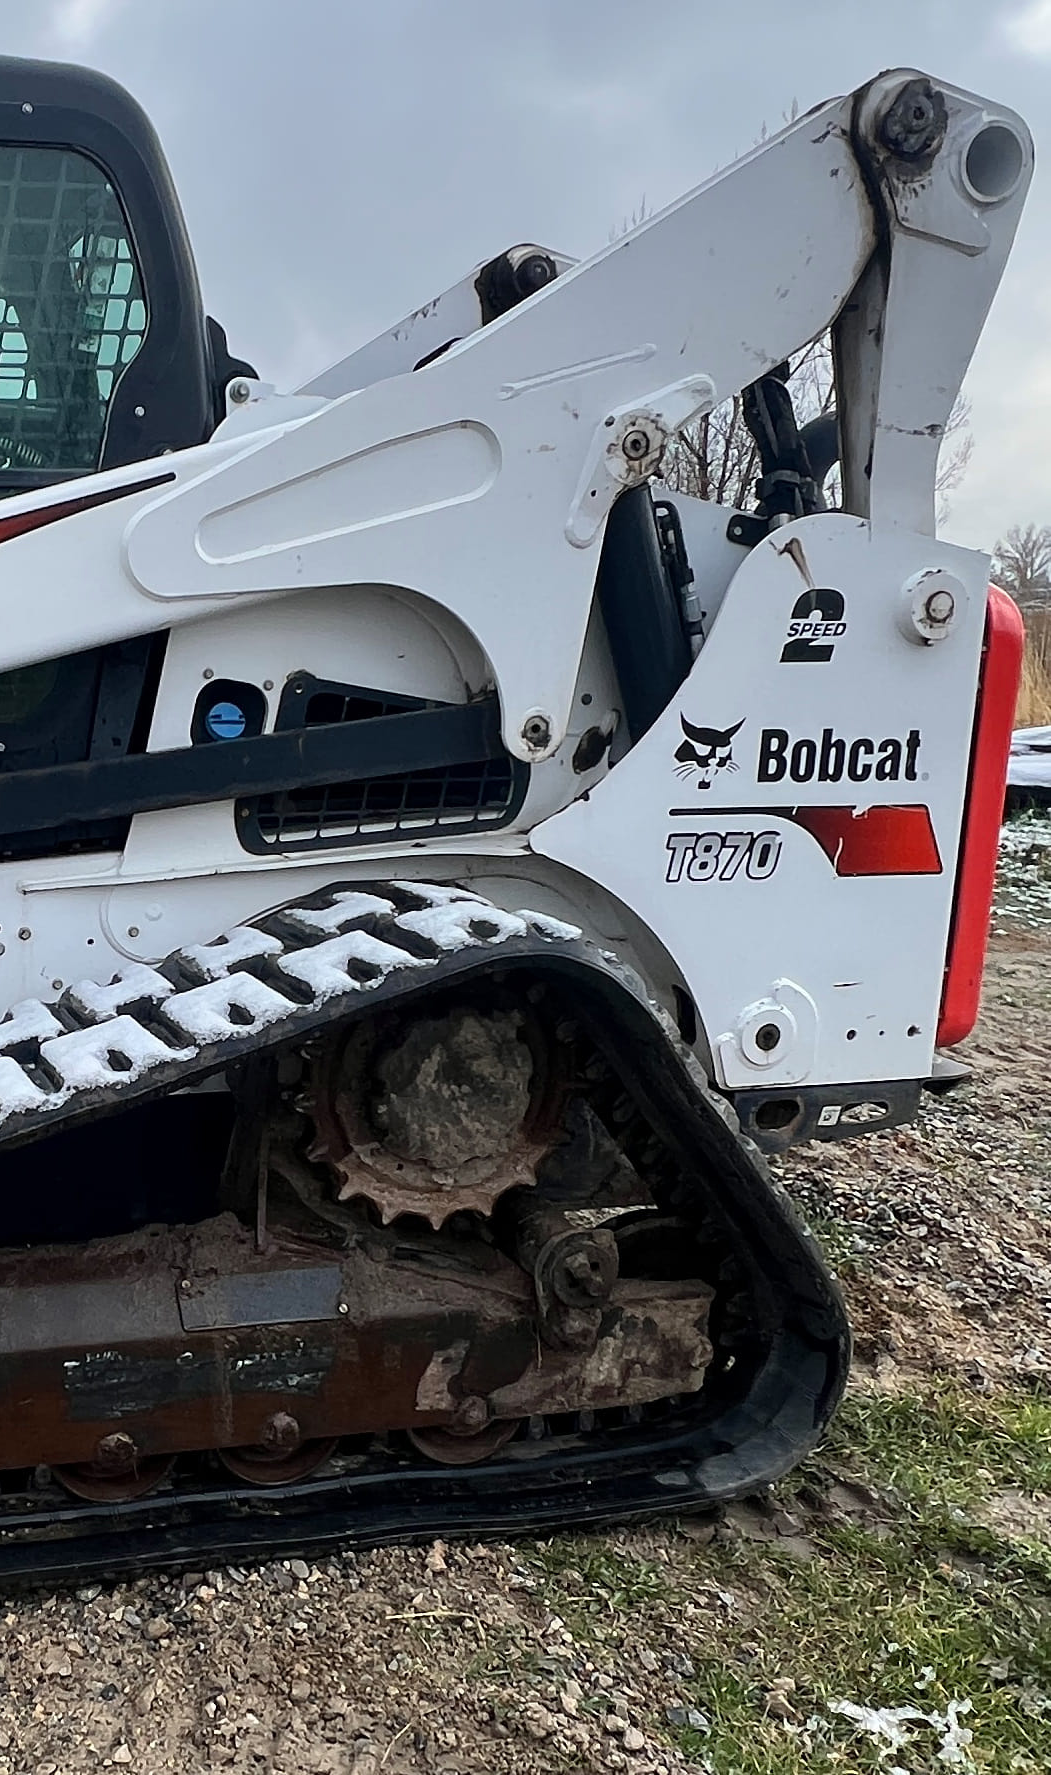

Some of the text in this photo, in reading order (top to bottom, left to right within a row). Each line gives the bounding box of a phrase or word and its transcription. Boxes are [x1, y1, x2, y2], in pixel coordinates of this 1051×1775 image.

[779, 588, 845, 663] 2
[787, 622, 847, 637] SPEED
[757, 728, 921, 783] Bobcat
[665, 831, 782, 883] T870
